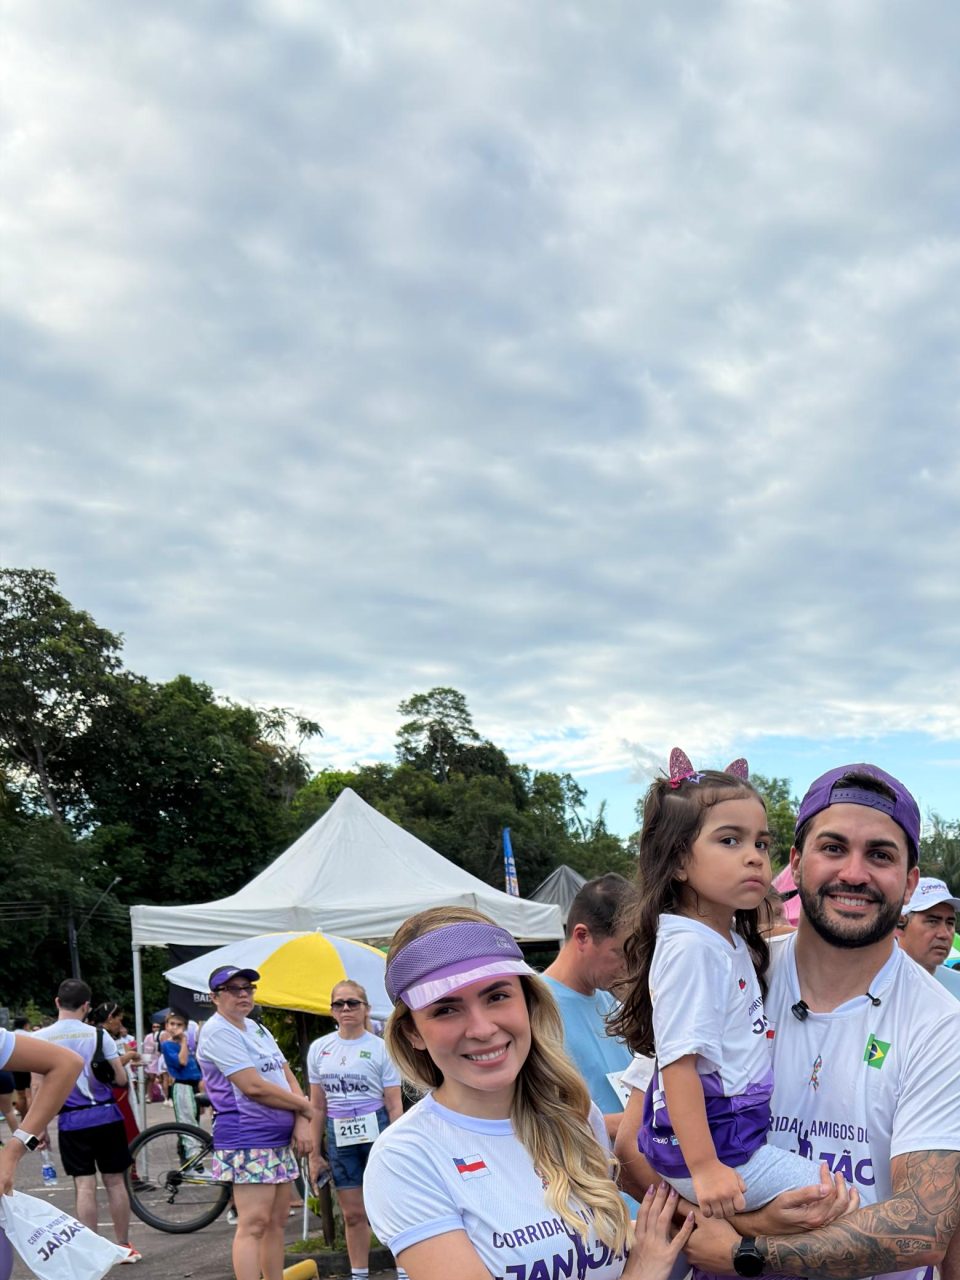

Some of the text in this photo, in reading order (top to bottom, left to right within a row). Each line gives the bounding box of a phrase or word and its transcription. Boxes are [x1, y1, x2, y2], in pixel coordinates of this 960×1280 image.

[340, 1123, 367, 1136] 2151
[768, 1116, 798, 1133] RIDA
[810, 1120, 855, 1141] AMIGOS
[493, 1219, 565, 1249] CORRIDA
